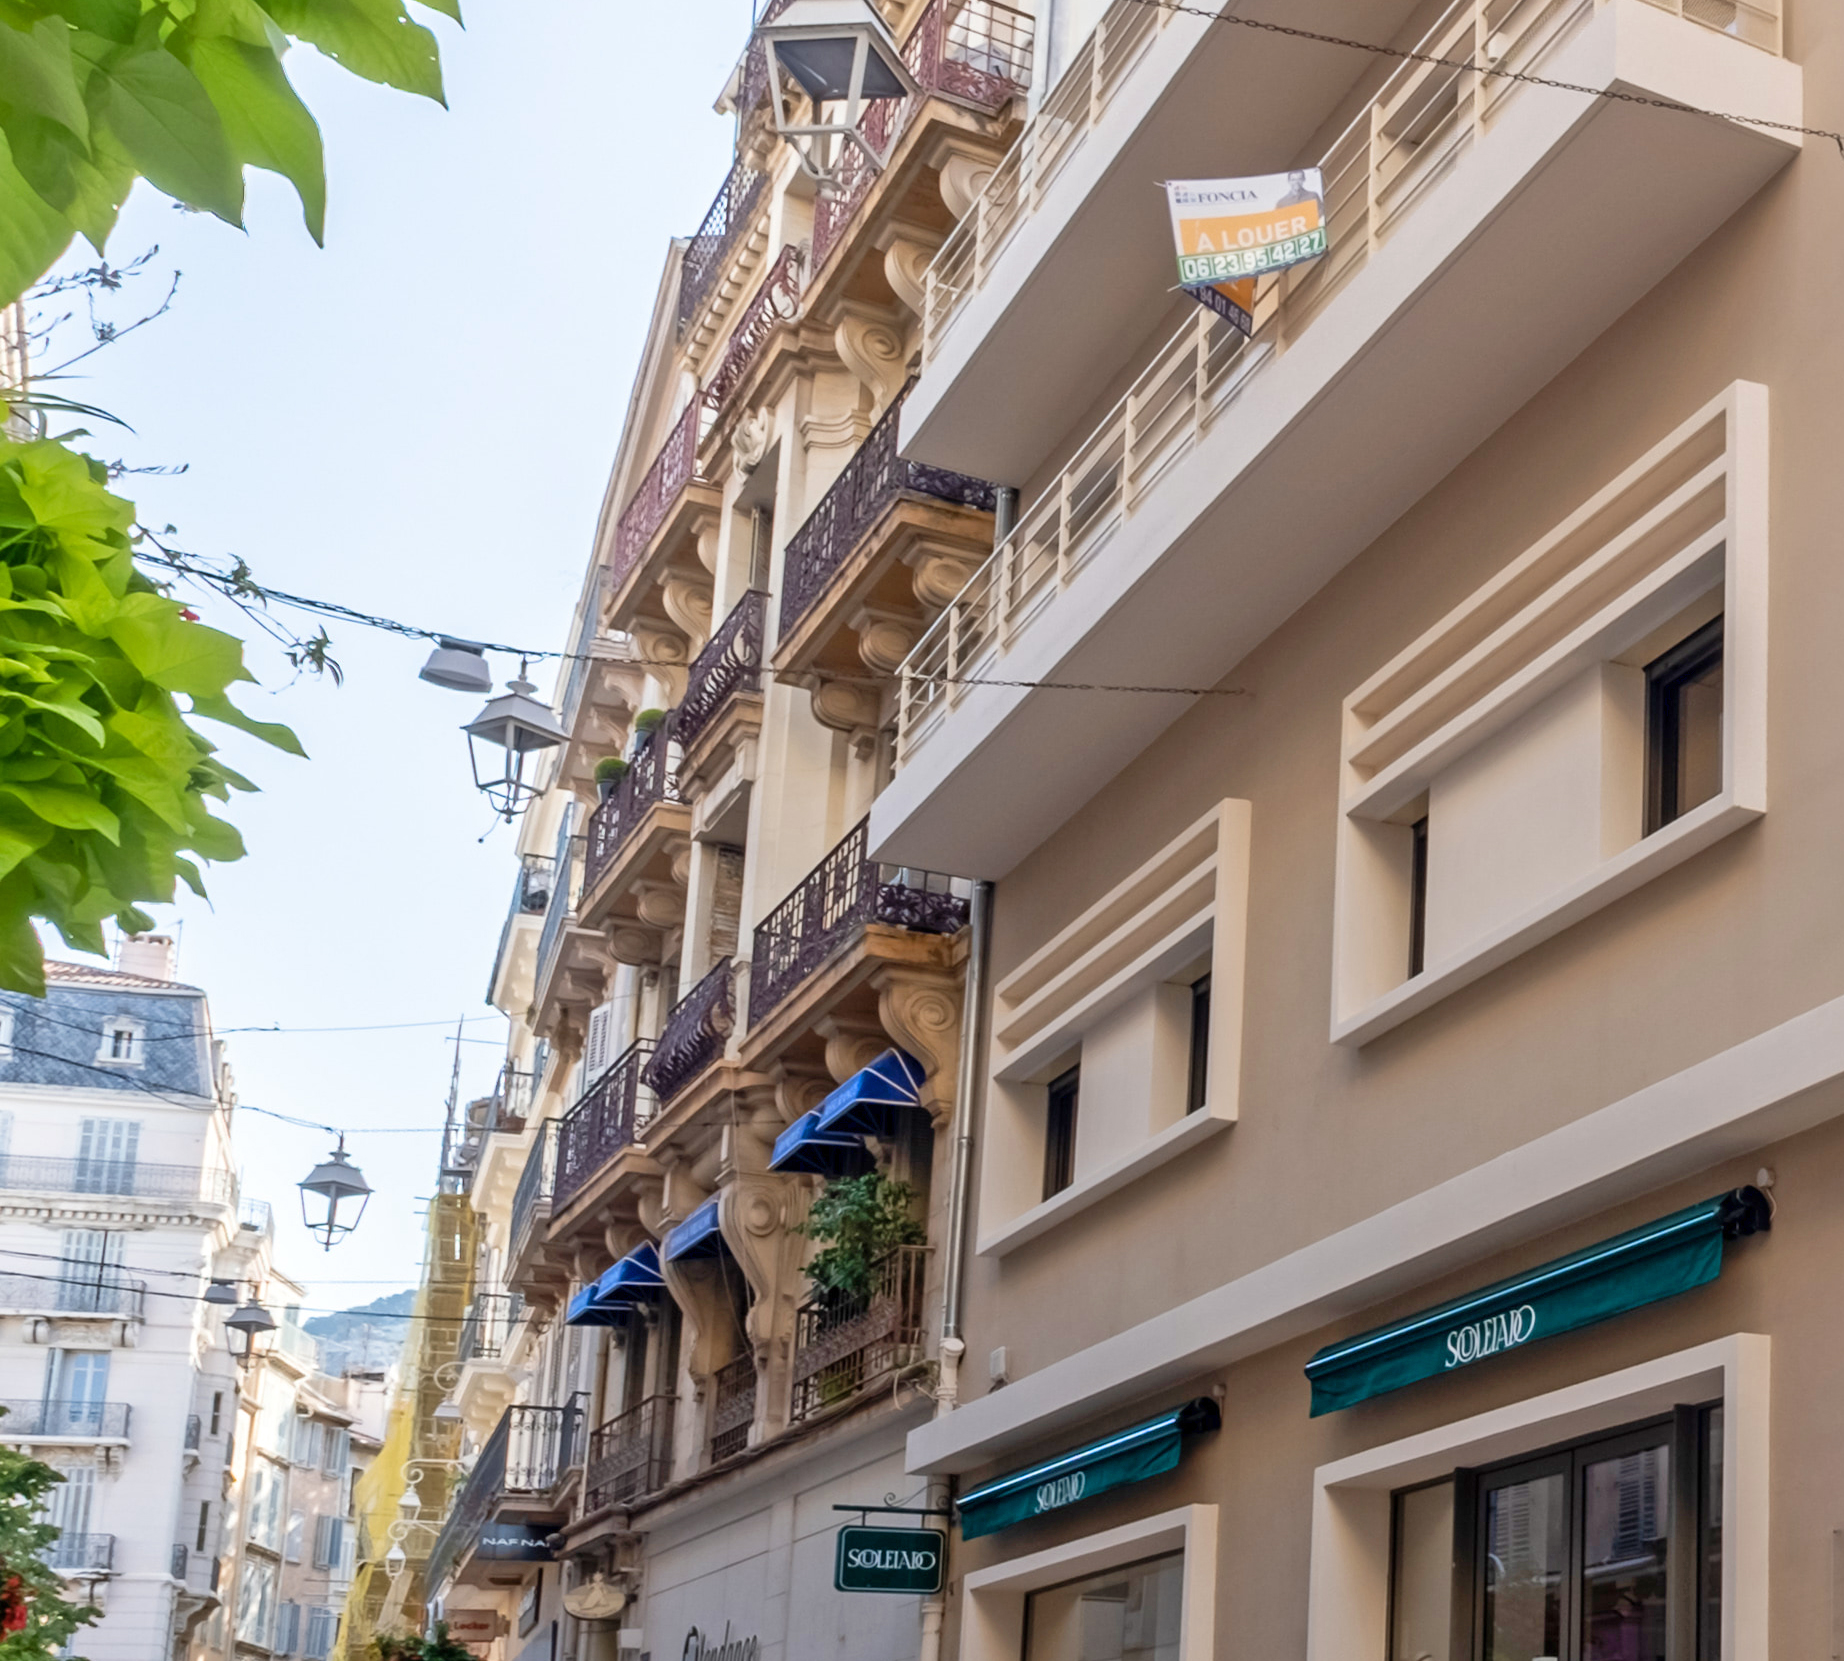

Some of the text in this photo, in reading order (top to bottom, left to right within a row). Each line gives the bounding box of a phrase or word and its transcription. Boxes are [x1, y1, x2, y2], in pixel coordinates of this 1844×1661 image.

[1197, 190, 1258, 204] FONCIA
[1221, 215, 1307, 249] LOUER
[1183, 231, 1321, 279] 06 23 95 42 27
[482, 1537, 551, 1548] NAF NA
